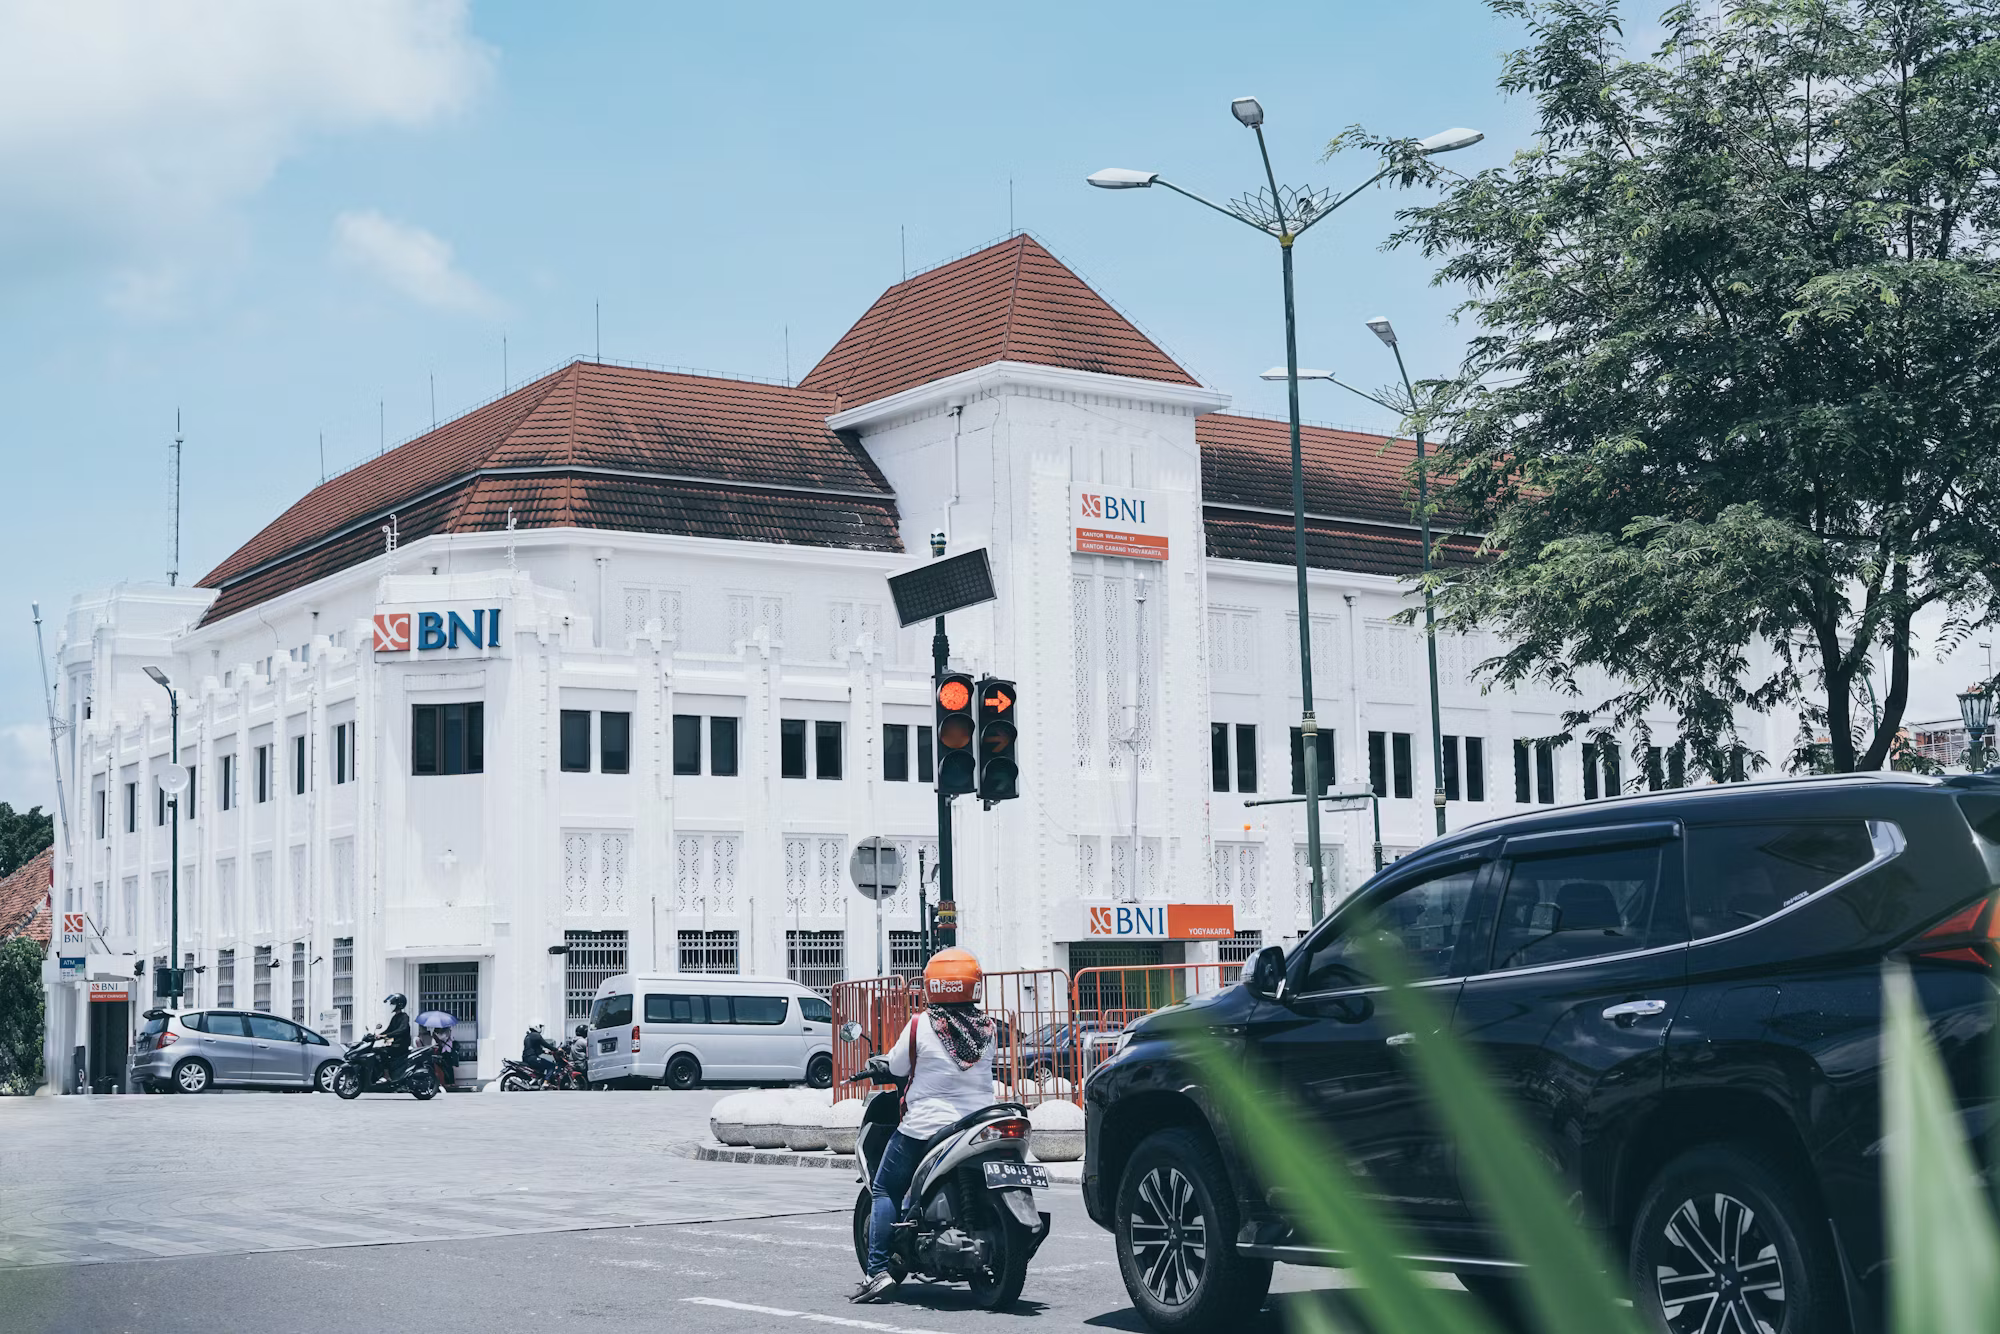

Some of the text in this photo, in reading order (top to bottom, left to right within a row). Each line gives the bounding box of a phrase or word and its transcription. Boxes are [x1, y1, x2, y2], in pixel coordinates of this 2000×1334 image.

[1104, 495, 1146, 524] BNI
[1082, 531, 1104, 539] KANTOR
[1082, 542, 1162, 556] KANTOR CABANG YOGYAKARTA
[417, 608, 501, 650] BNI
[1116, 907, 1164, 935] BNI
[1188, 927, 1231, 936] YOGYAKARTA
[64, 934, 83, 943] BNI
[941, 984, 963, 993] Food
[986, 1163, 1001, 1175] AB
[1003, 1164, 1028, 1176] 6819
